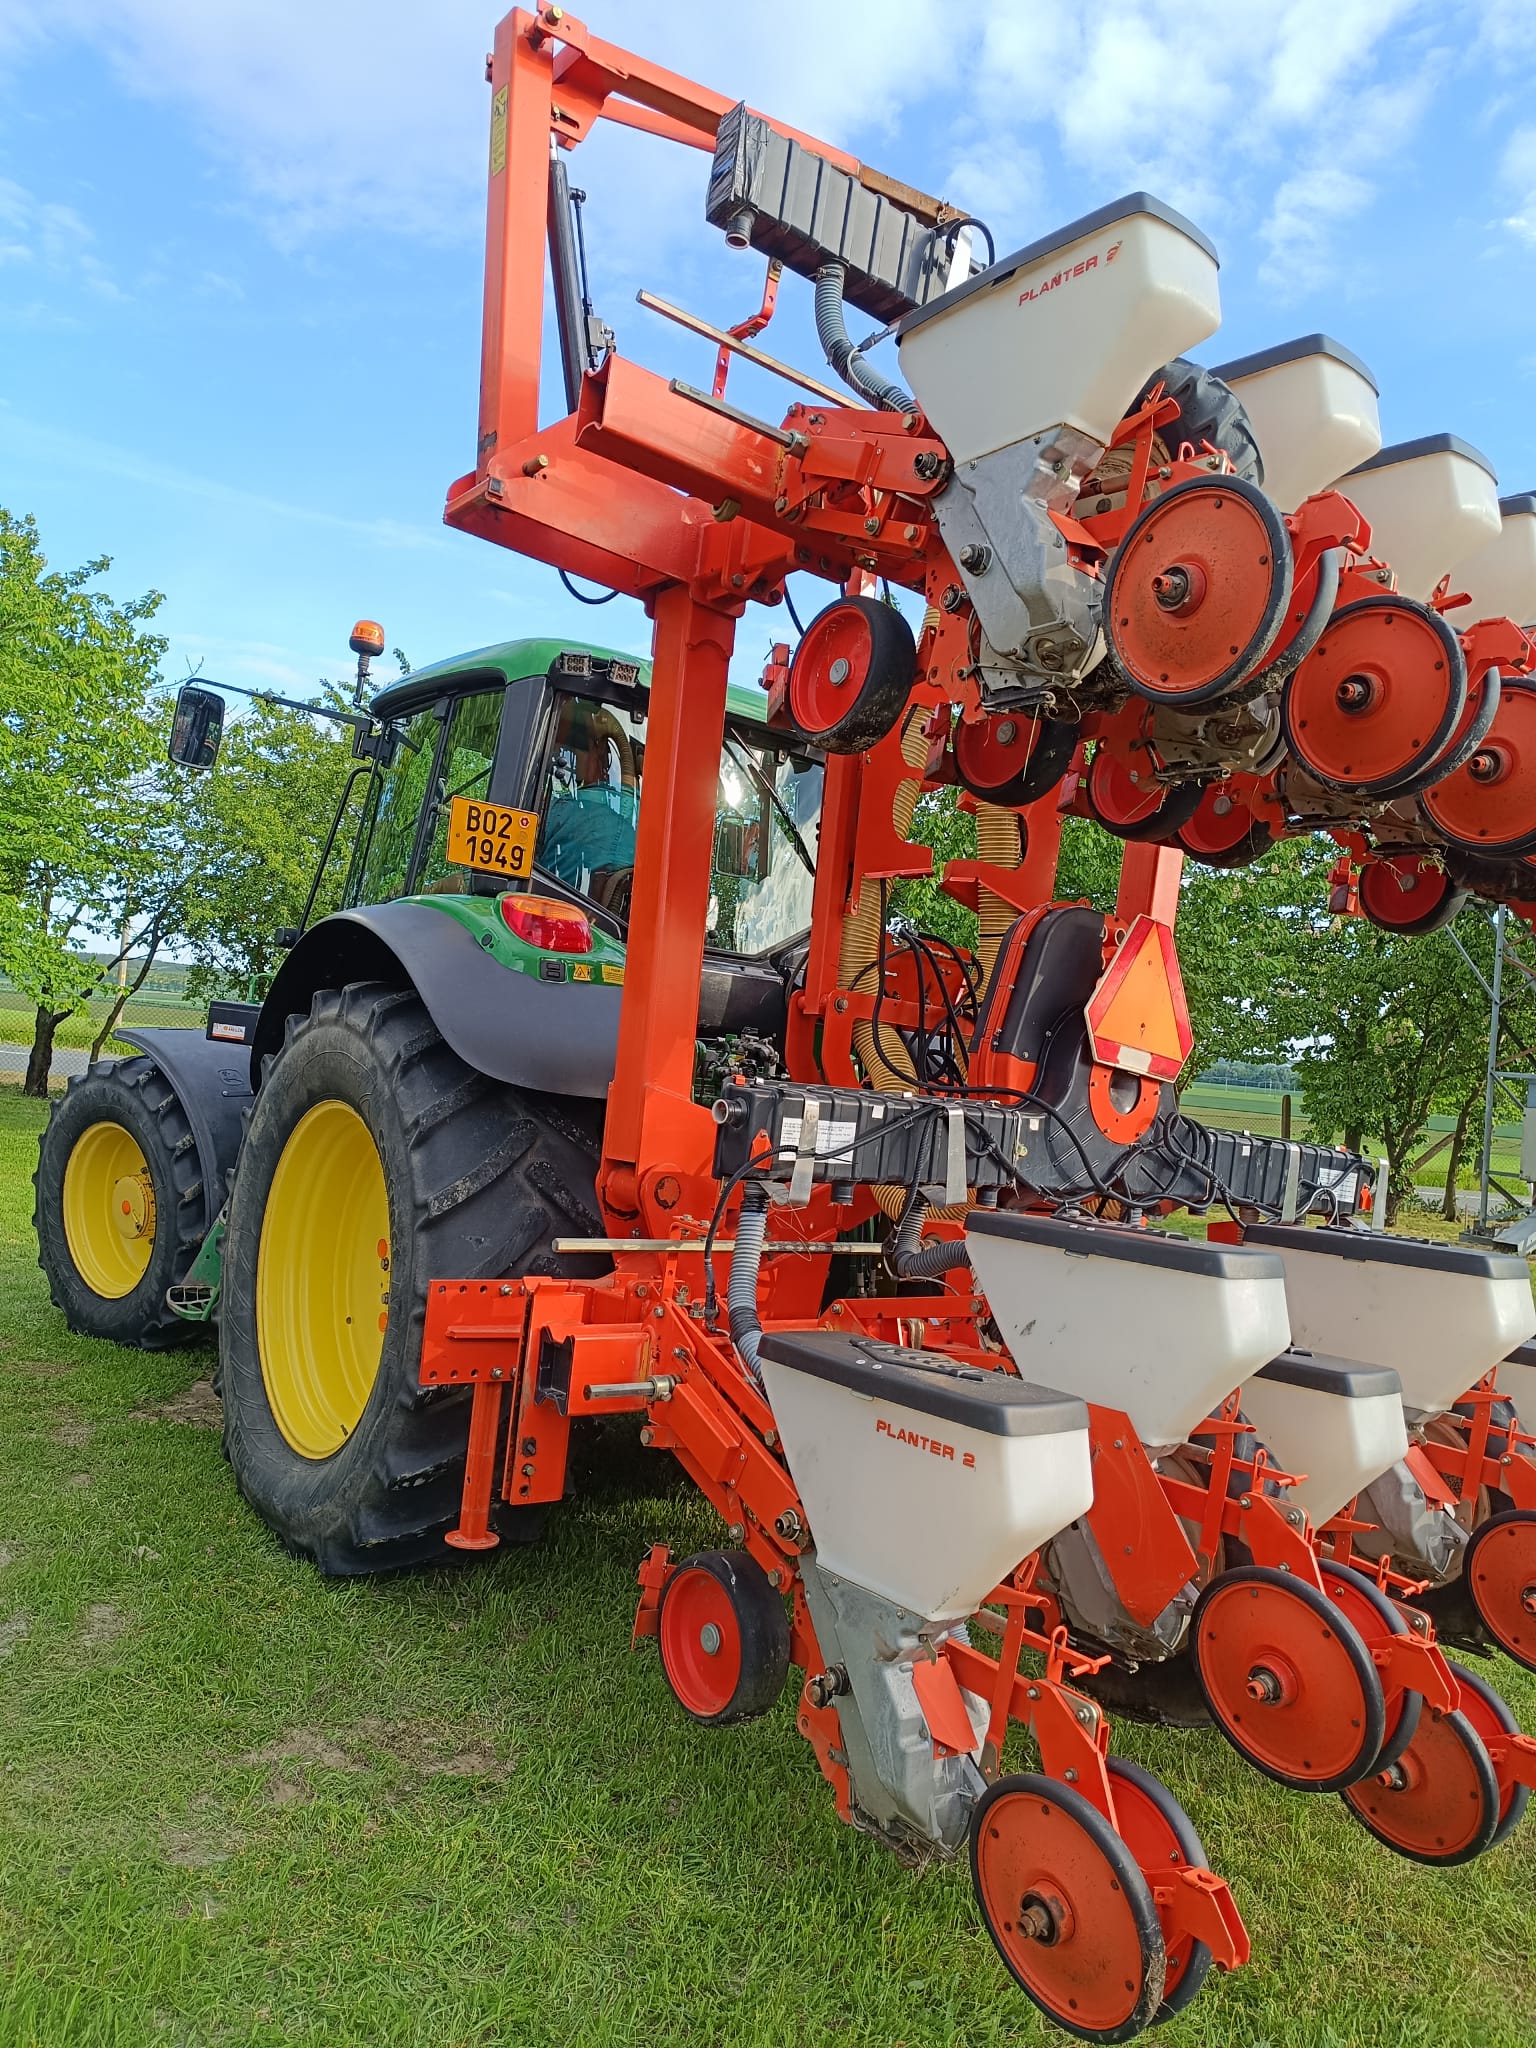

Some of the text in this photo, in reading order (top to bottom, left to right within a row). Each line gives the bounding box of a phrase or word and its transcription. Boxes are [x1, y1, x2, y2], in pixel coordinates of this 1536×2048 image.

[1018, 255, 1098, 306] PLANTER
[466, 804, 513, 840] B02
[466, 835, 524, 871] 1949
[876, 1419, 976, 1468] PLANTER 2
